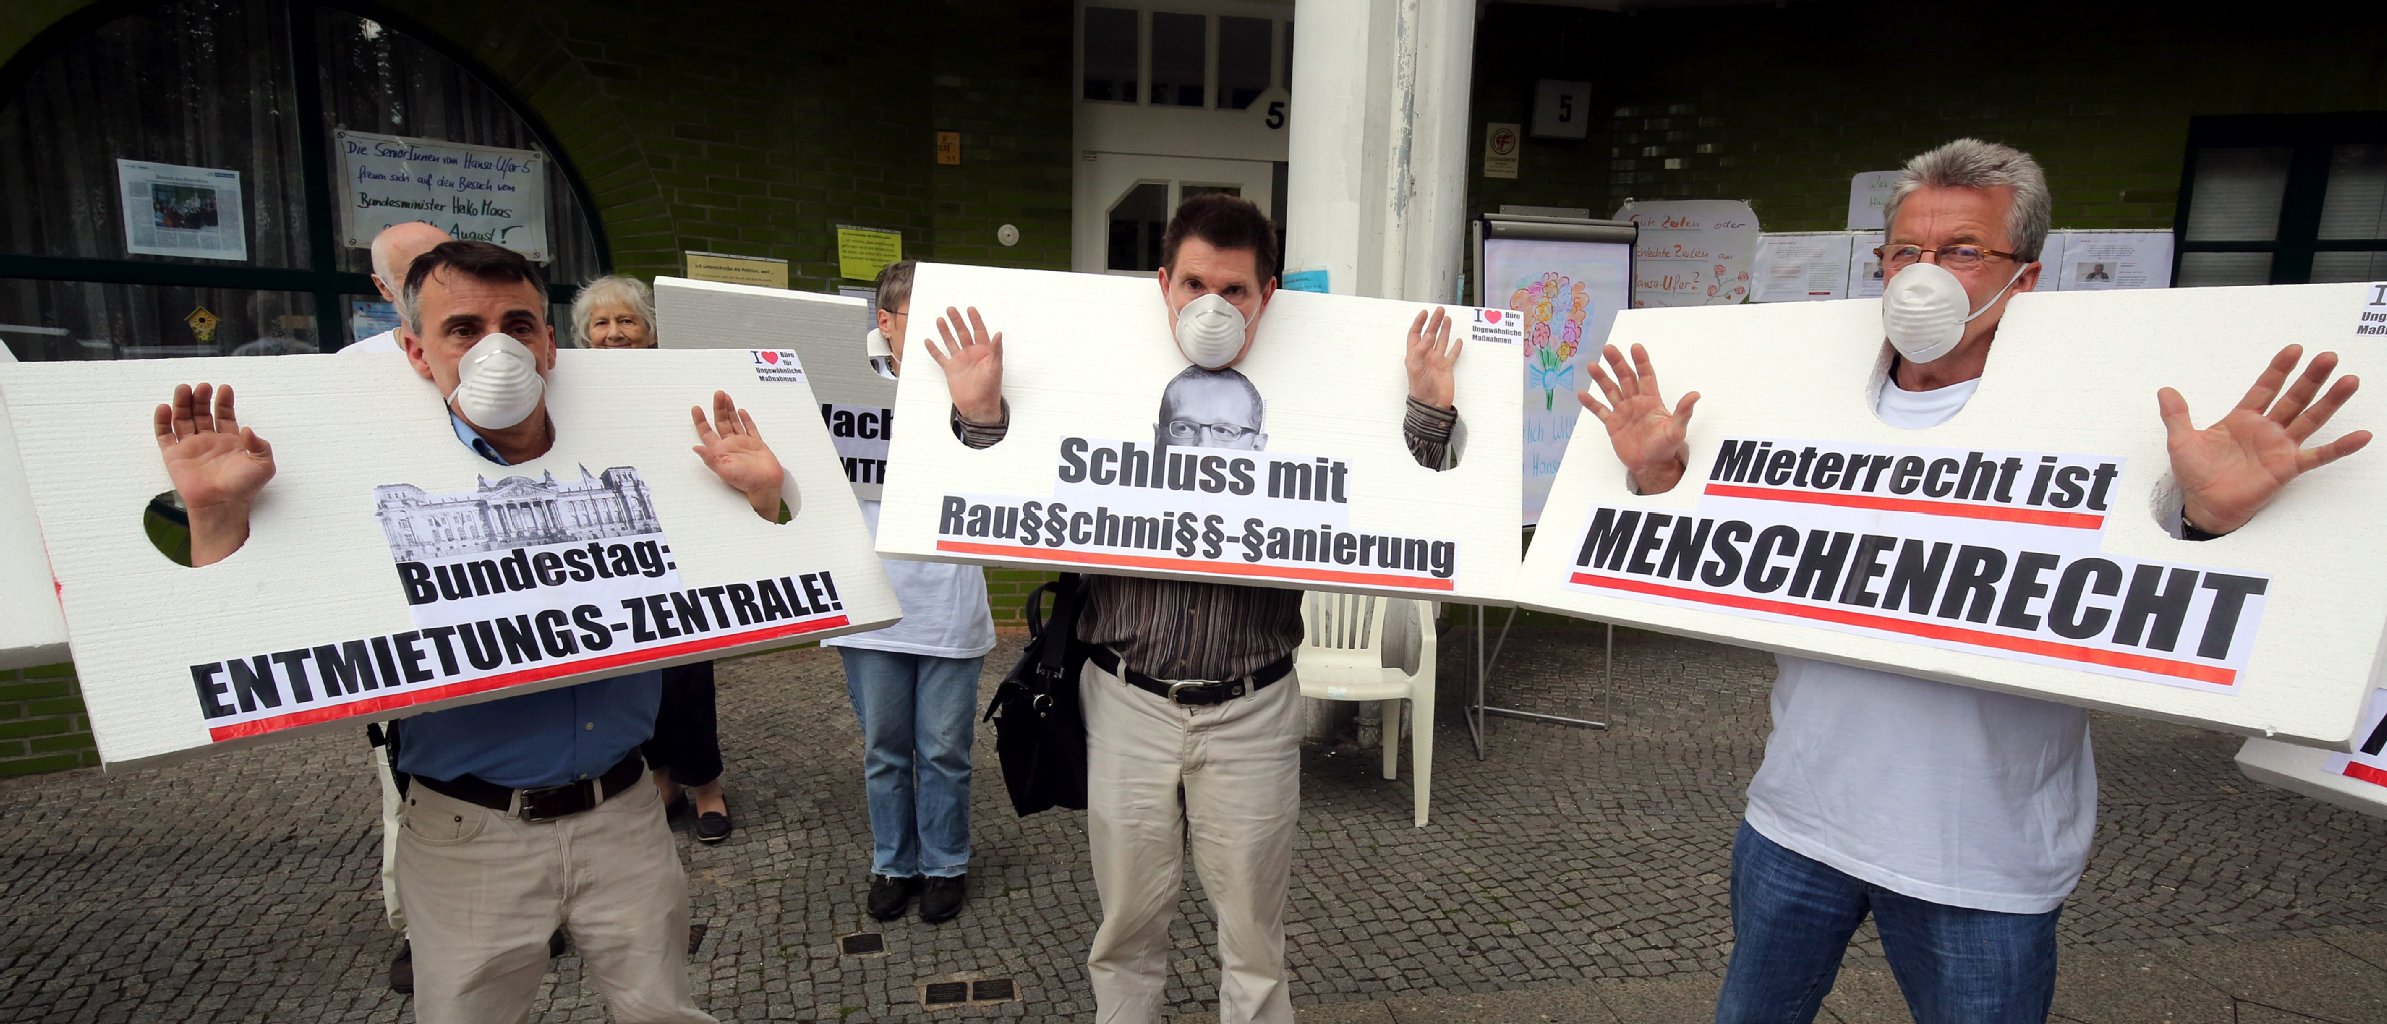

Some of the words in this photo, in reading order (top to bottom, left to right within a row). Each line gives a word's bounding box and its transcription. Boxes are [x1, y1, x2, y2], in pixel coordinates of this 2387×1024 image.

[1265, 101, 1285, 130] 5
[1559, 95, 1573, 123] 5
[347, 141, 368, 156] Die
[390, 173, 410, 183] sich
[417, 174, 433, 191] auf
[437, 178, 454, 189] den
[459, 177, 493, 192] Besuch
[357, 192, 446, 212] Bundesminister
[481, 199, 512, 219] Maas
[1661, 215, 1700, 229] Zeiten
[1714, 220, 1745, 230] oder
[1636, 246, 1671, 258] chlechte
[1674, 244, 1709, 258] Zeiten
[2369, 285, 2387, 306] I
[1474, 308, 1483, 322] I
[1472, 326, 1522, 336] Ungewöhnliche
[1472, 334, 1512, 344] Maßnahmen
[750, 350, 763, 364] I
[1058, 437, 1255, 496] Schluss
[1267, 457, 1348, 504] mit
[1710, 439, 2016, 504] Mieterrecht
[2026, 455, 2118, 512] ist
[938, 496, 1455, 578] Rau§§chmi§§-§anierung
[396, 540, 678, 606] Bundestag:
[1576, 507, 2269, 661] MENSCHENRECHT
[189, 570, 843, 720] ENTMIETUNGS-ZENTRALE!
